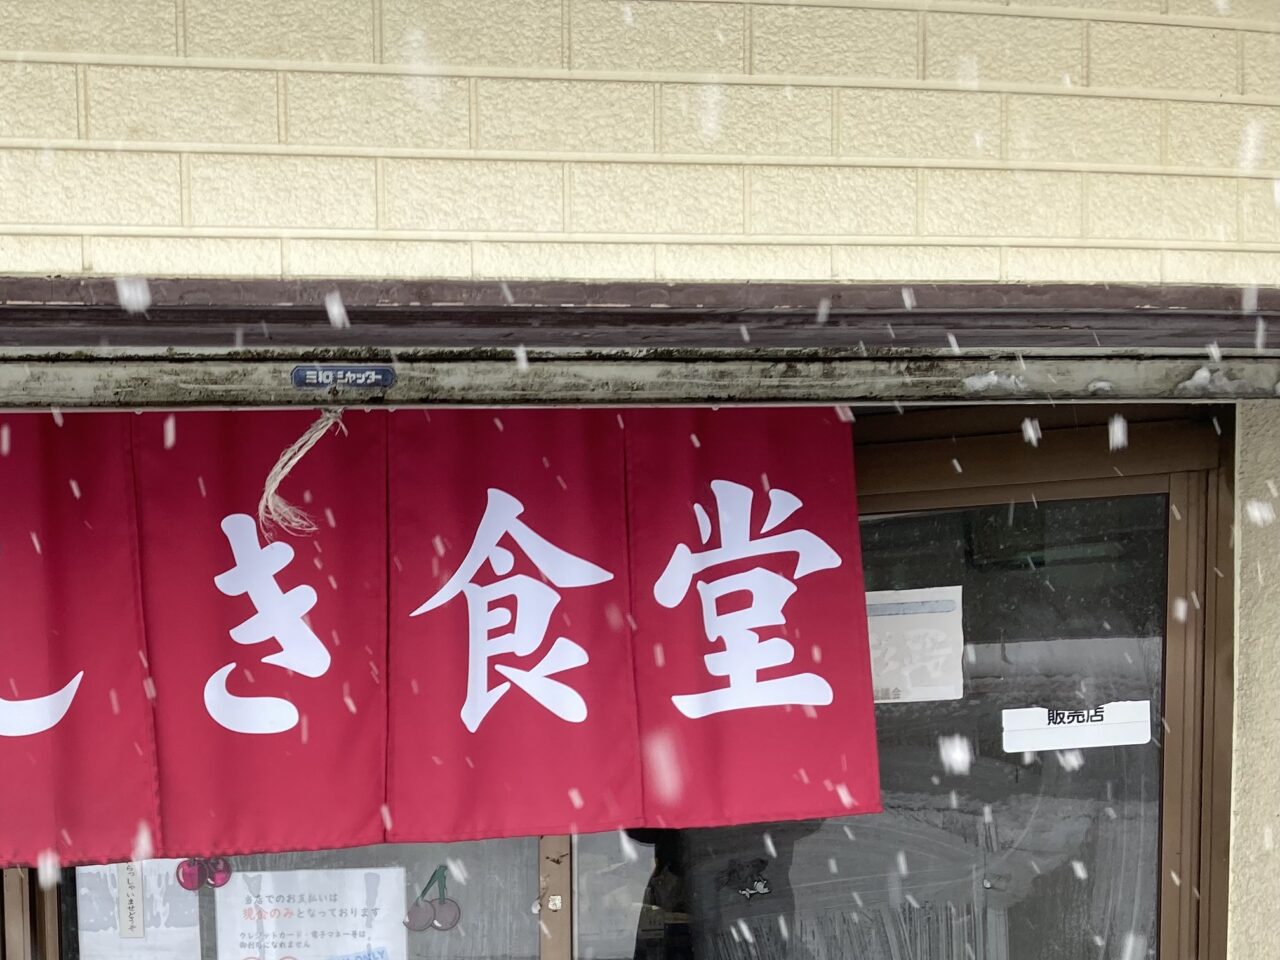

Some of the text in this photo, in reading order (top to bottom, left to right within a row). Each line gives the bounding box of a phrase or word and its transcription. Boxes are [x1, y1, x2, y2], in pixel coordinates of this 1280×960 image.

[1047, 708, 1105, 726] 販売店
[242, 906, 382, 921] 現金のみとなっております
